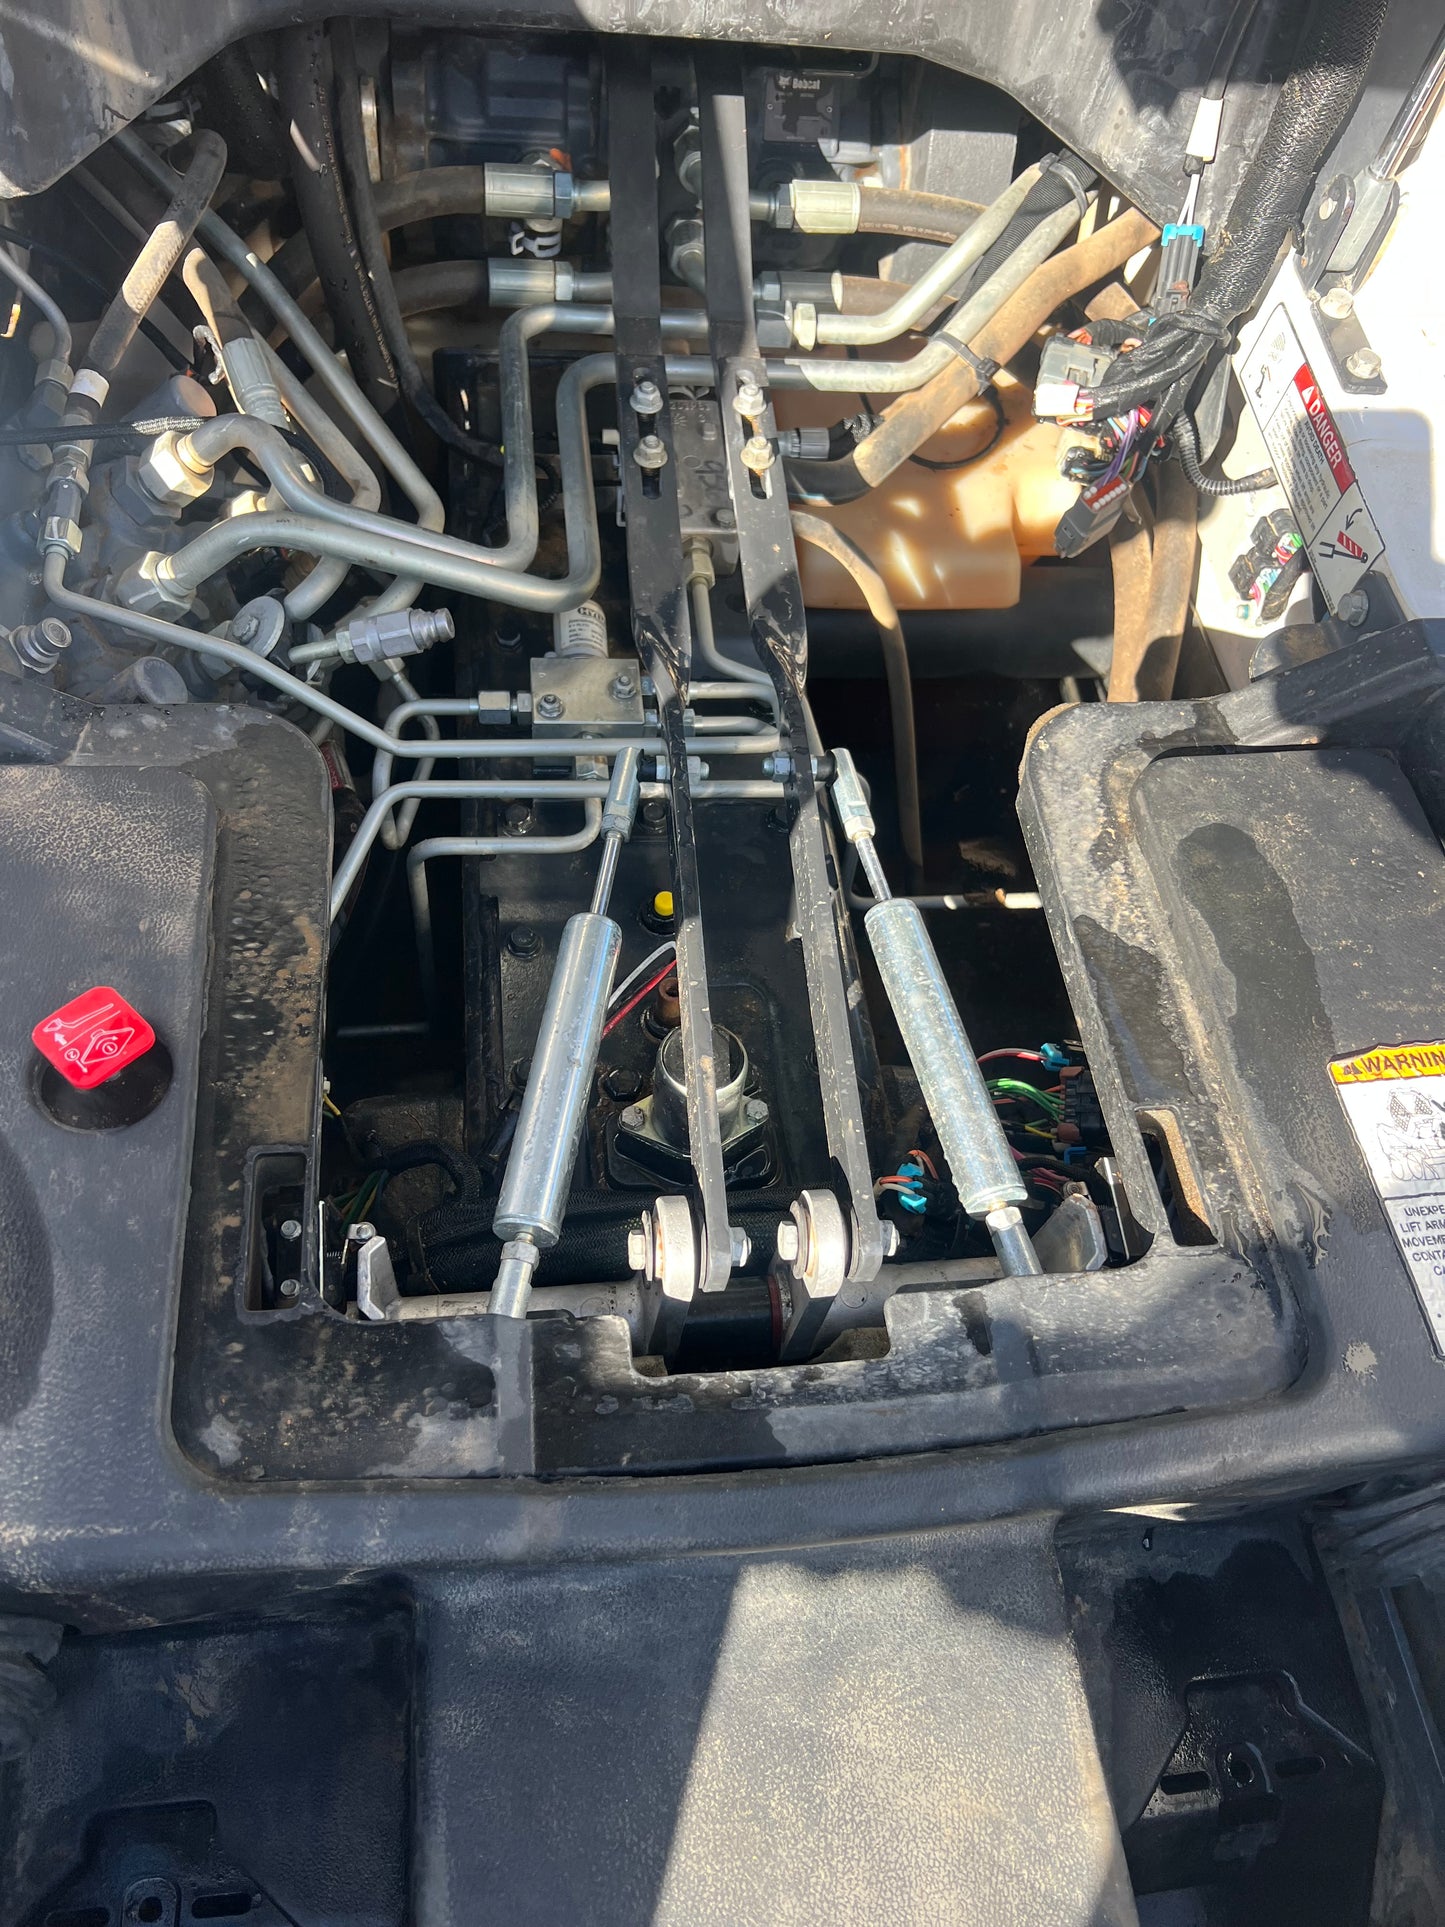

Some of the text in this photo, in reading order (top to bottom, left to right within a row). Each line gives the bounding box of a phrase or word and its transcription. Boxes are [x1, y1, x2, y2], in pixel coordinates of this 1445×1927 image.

[792, 78, 820, 89] Bobcat
[1304, 419, 1325, 465] AVOID DEATH
[1308, 401, 1342, 469] DANGER
[1400, 1221, 1421, 1233] LIFT
